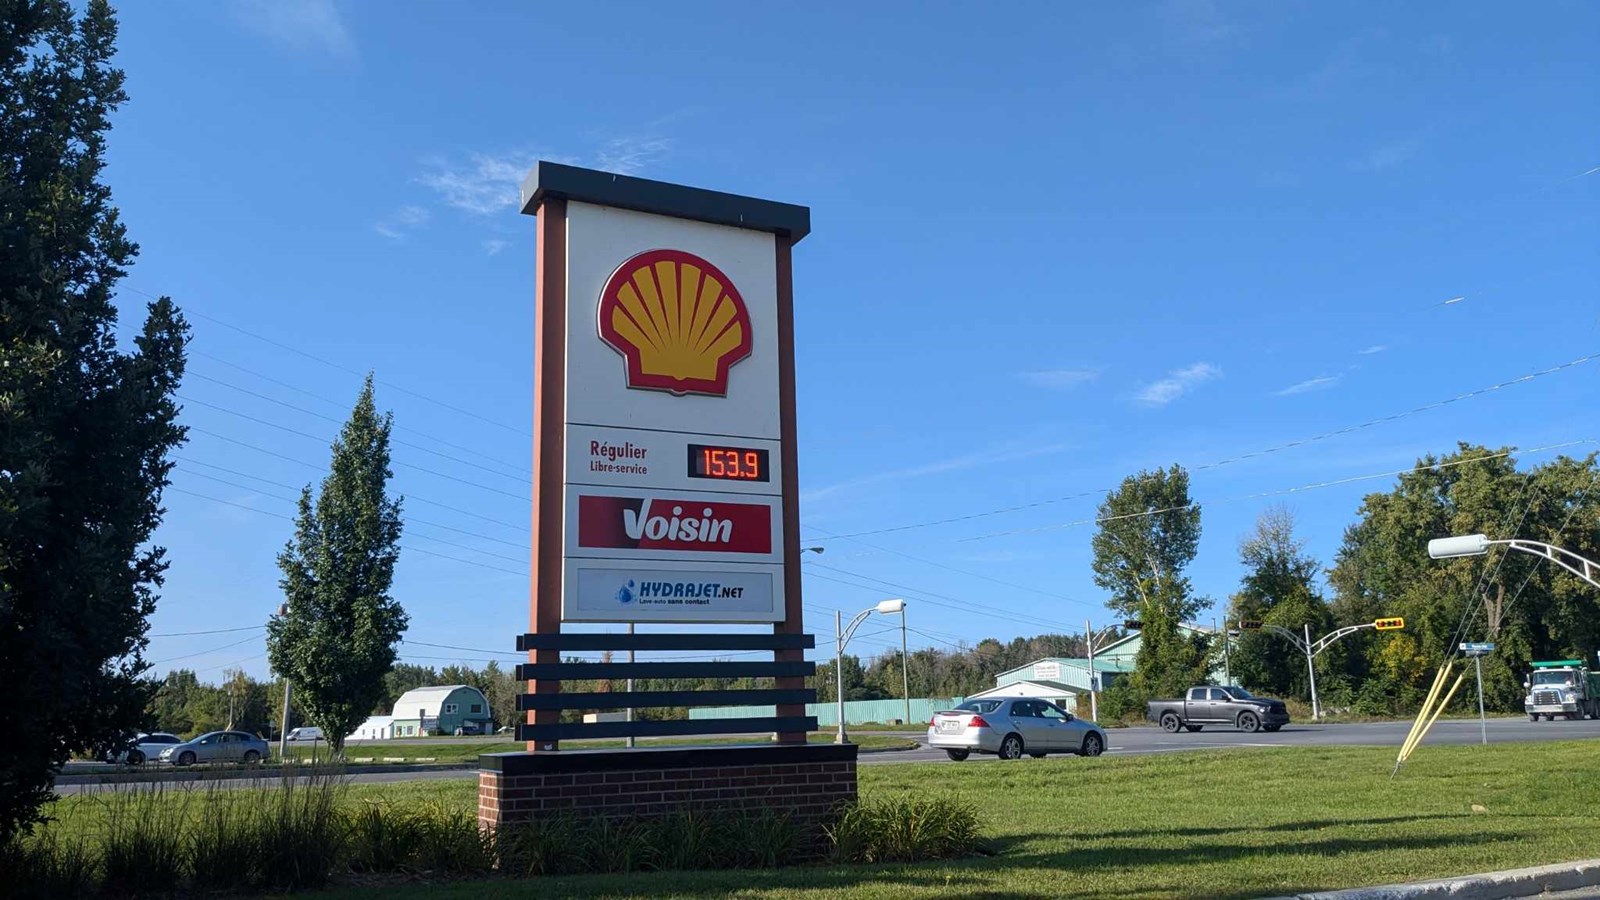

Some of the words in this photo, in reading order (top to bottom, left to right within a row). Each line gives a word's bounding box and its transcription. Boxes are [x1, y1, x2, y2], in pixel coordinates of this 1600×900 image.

[590, 440, 647, 462] Régulier
[590, 461, 647, 475] Libre-service
[704, 449, 758, 478] 153.9
[623, 499, 733, 543] Voisin
[640, 581, 744, 598] HYDRAJET.NET
